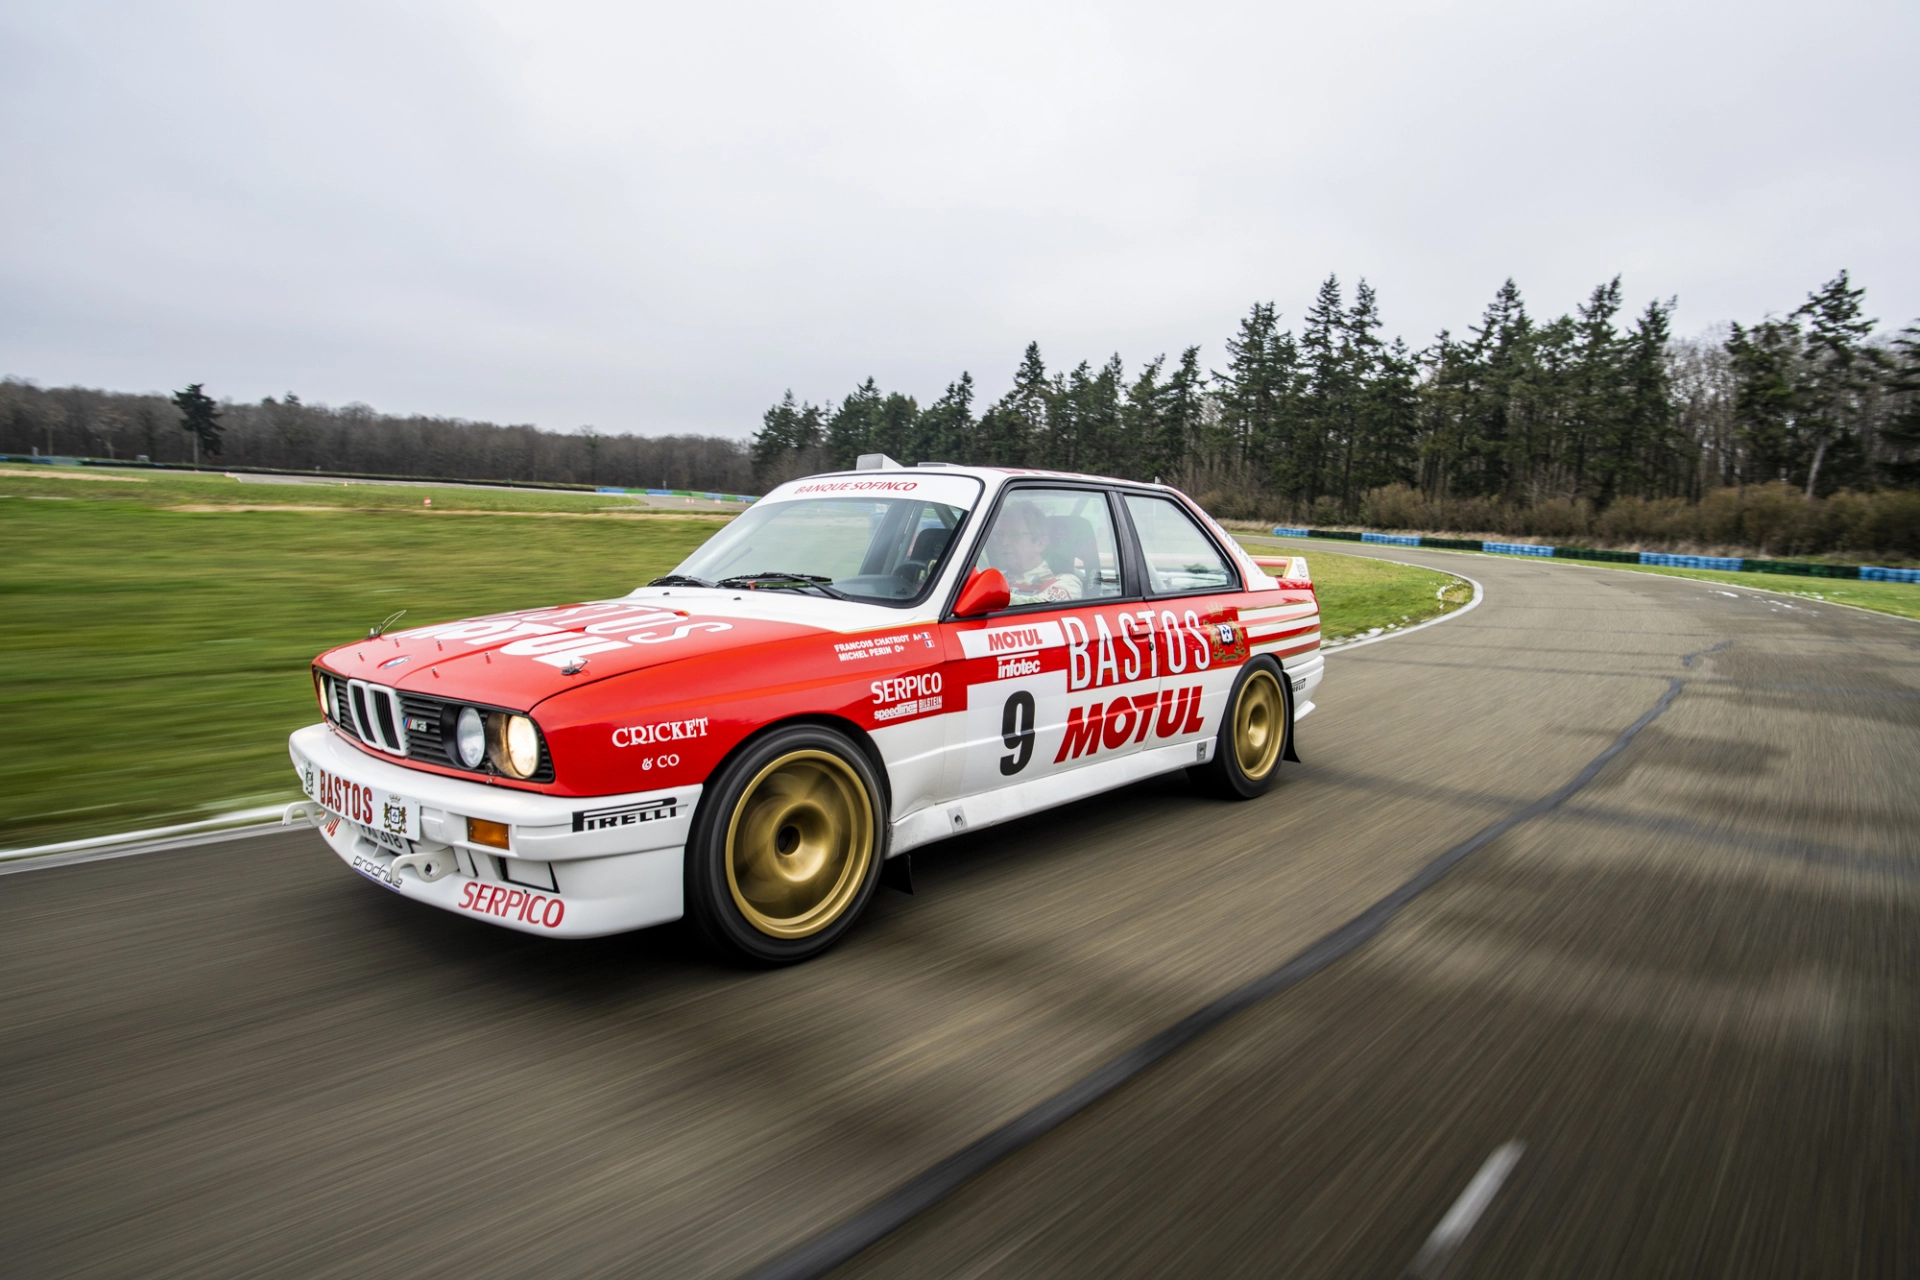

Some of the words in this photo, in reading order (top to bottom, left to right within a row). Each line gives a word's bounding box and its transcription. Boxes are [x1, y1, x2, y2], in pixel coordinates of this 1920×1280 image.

[793, 482, 853, 495] BANQUE
[850, 481, 918, 491] SOFINCO
[834, 639, 874, 652] FRANCOIS
[874, 634, 910, 647] CHATRIOT
[838, 650, 869, 662] MICHEL
[869, 647, 892, 657] PERIN
[987, 629, 1043, 651] MOTUL
[1061, 610, 1210, 690] BASTOS
[997, 659, 1041, 679] infotec
[870, 672, 942, 704] SERPICO
[611, 716, 709, 748] CRICKET
[999, 690, 1036, 776] 9
[1053, 685, 1204, 764] MOTUL
[641, 757, 654, 771] &
[656, 753, 680, 768] CO
[320, 769, 373, 825] BASTOS
[571, 796, 678, 833] PIRELLI
[458, 881, 566, 929] SERPICO
